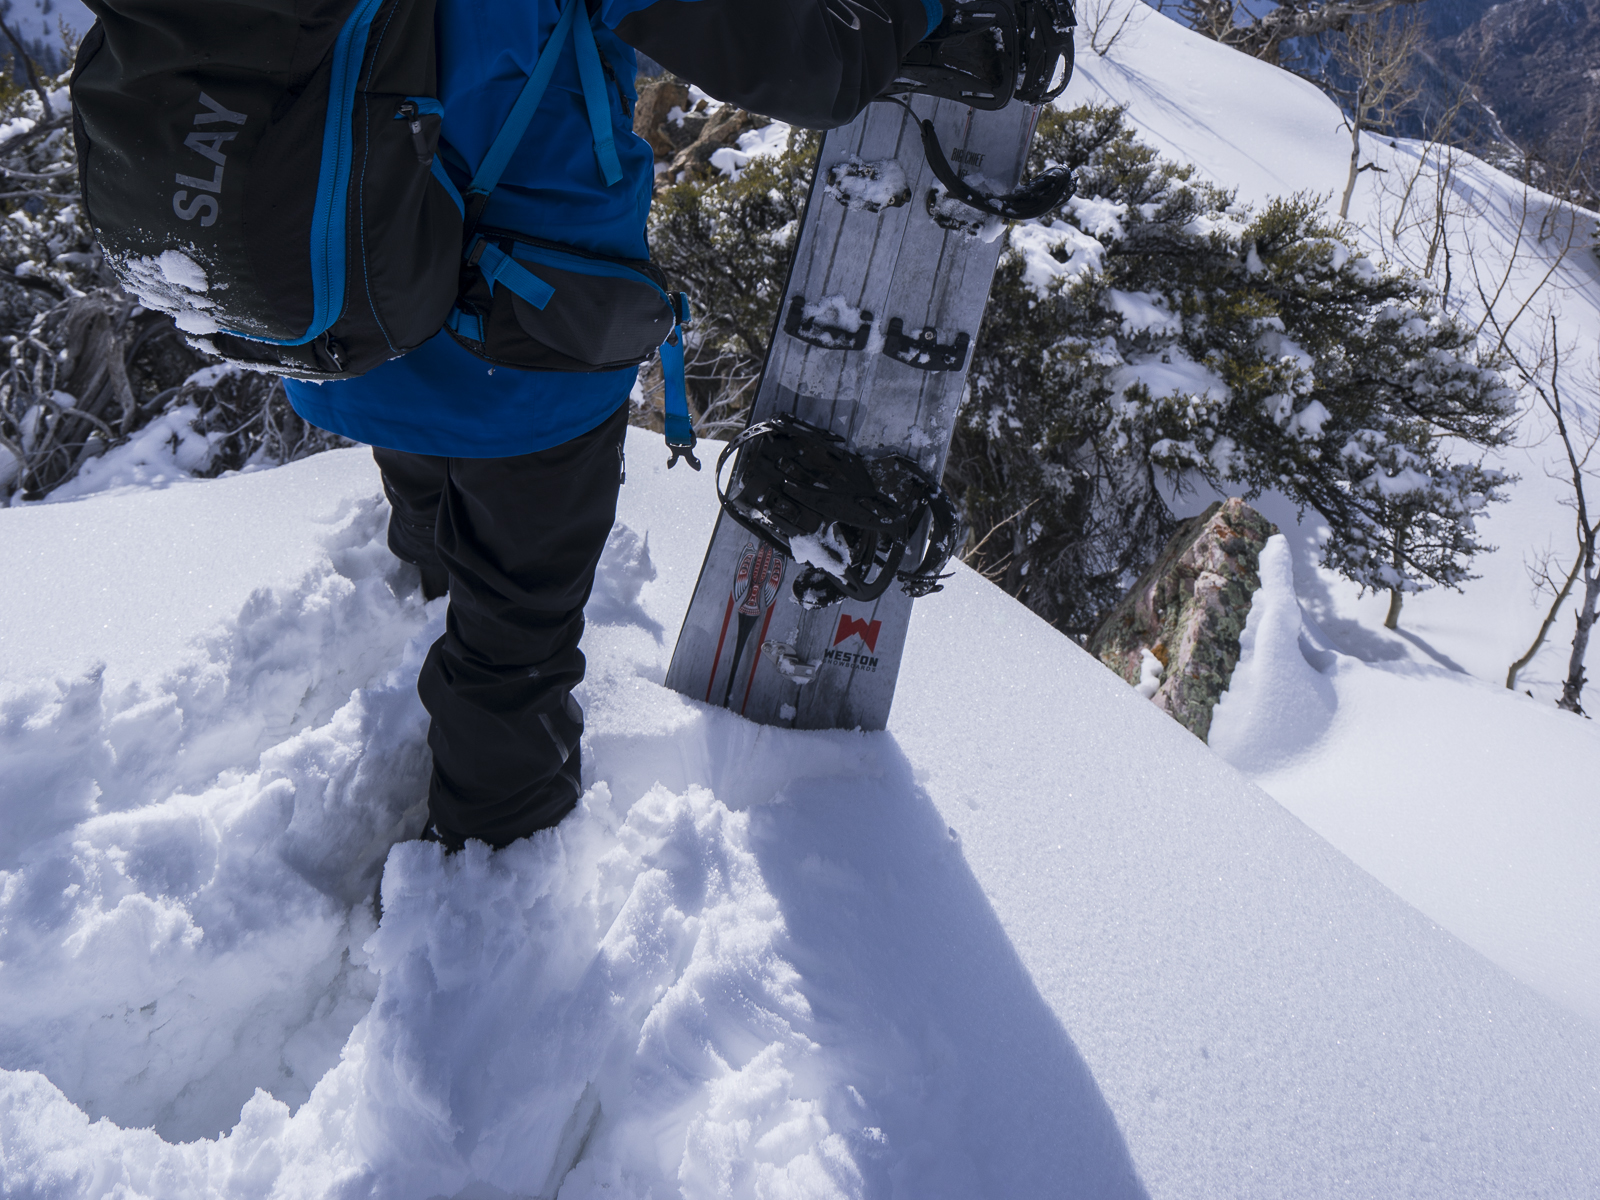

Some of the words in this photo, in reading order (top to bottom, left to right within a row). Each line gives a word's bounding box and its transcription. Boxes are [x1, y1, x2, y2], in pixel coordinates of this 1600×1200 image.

[172, 91, 248, 227] SLAY
[965, 151, 985, 167] CHIEF
[822, 658, 877, 673] SNOWBOARDS
[824, 648, 879, 668] WESTON
